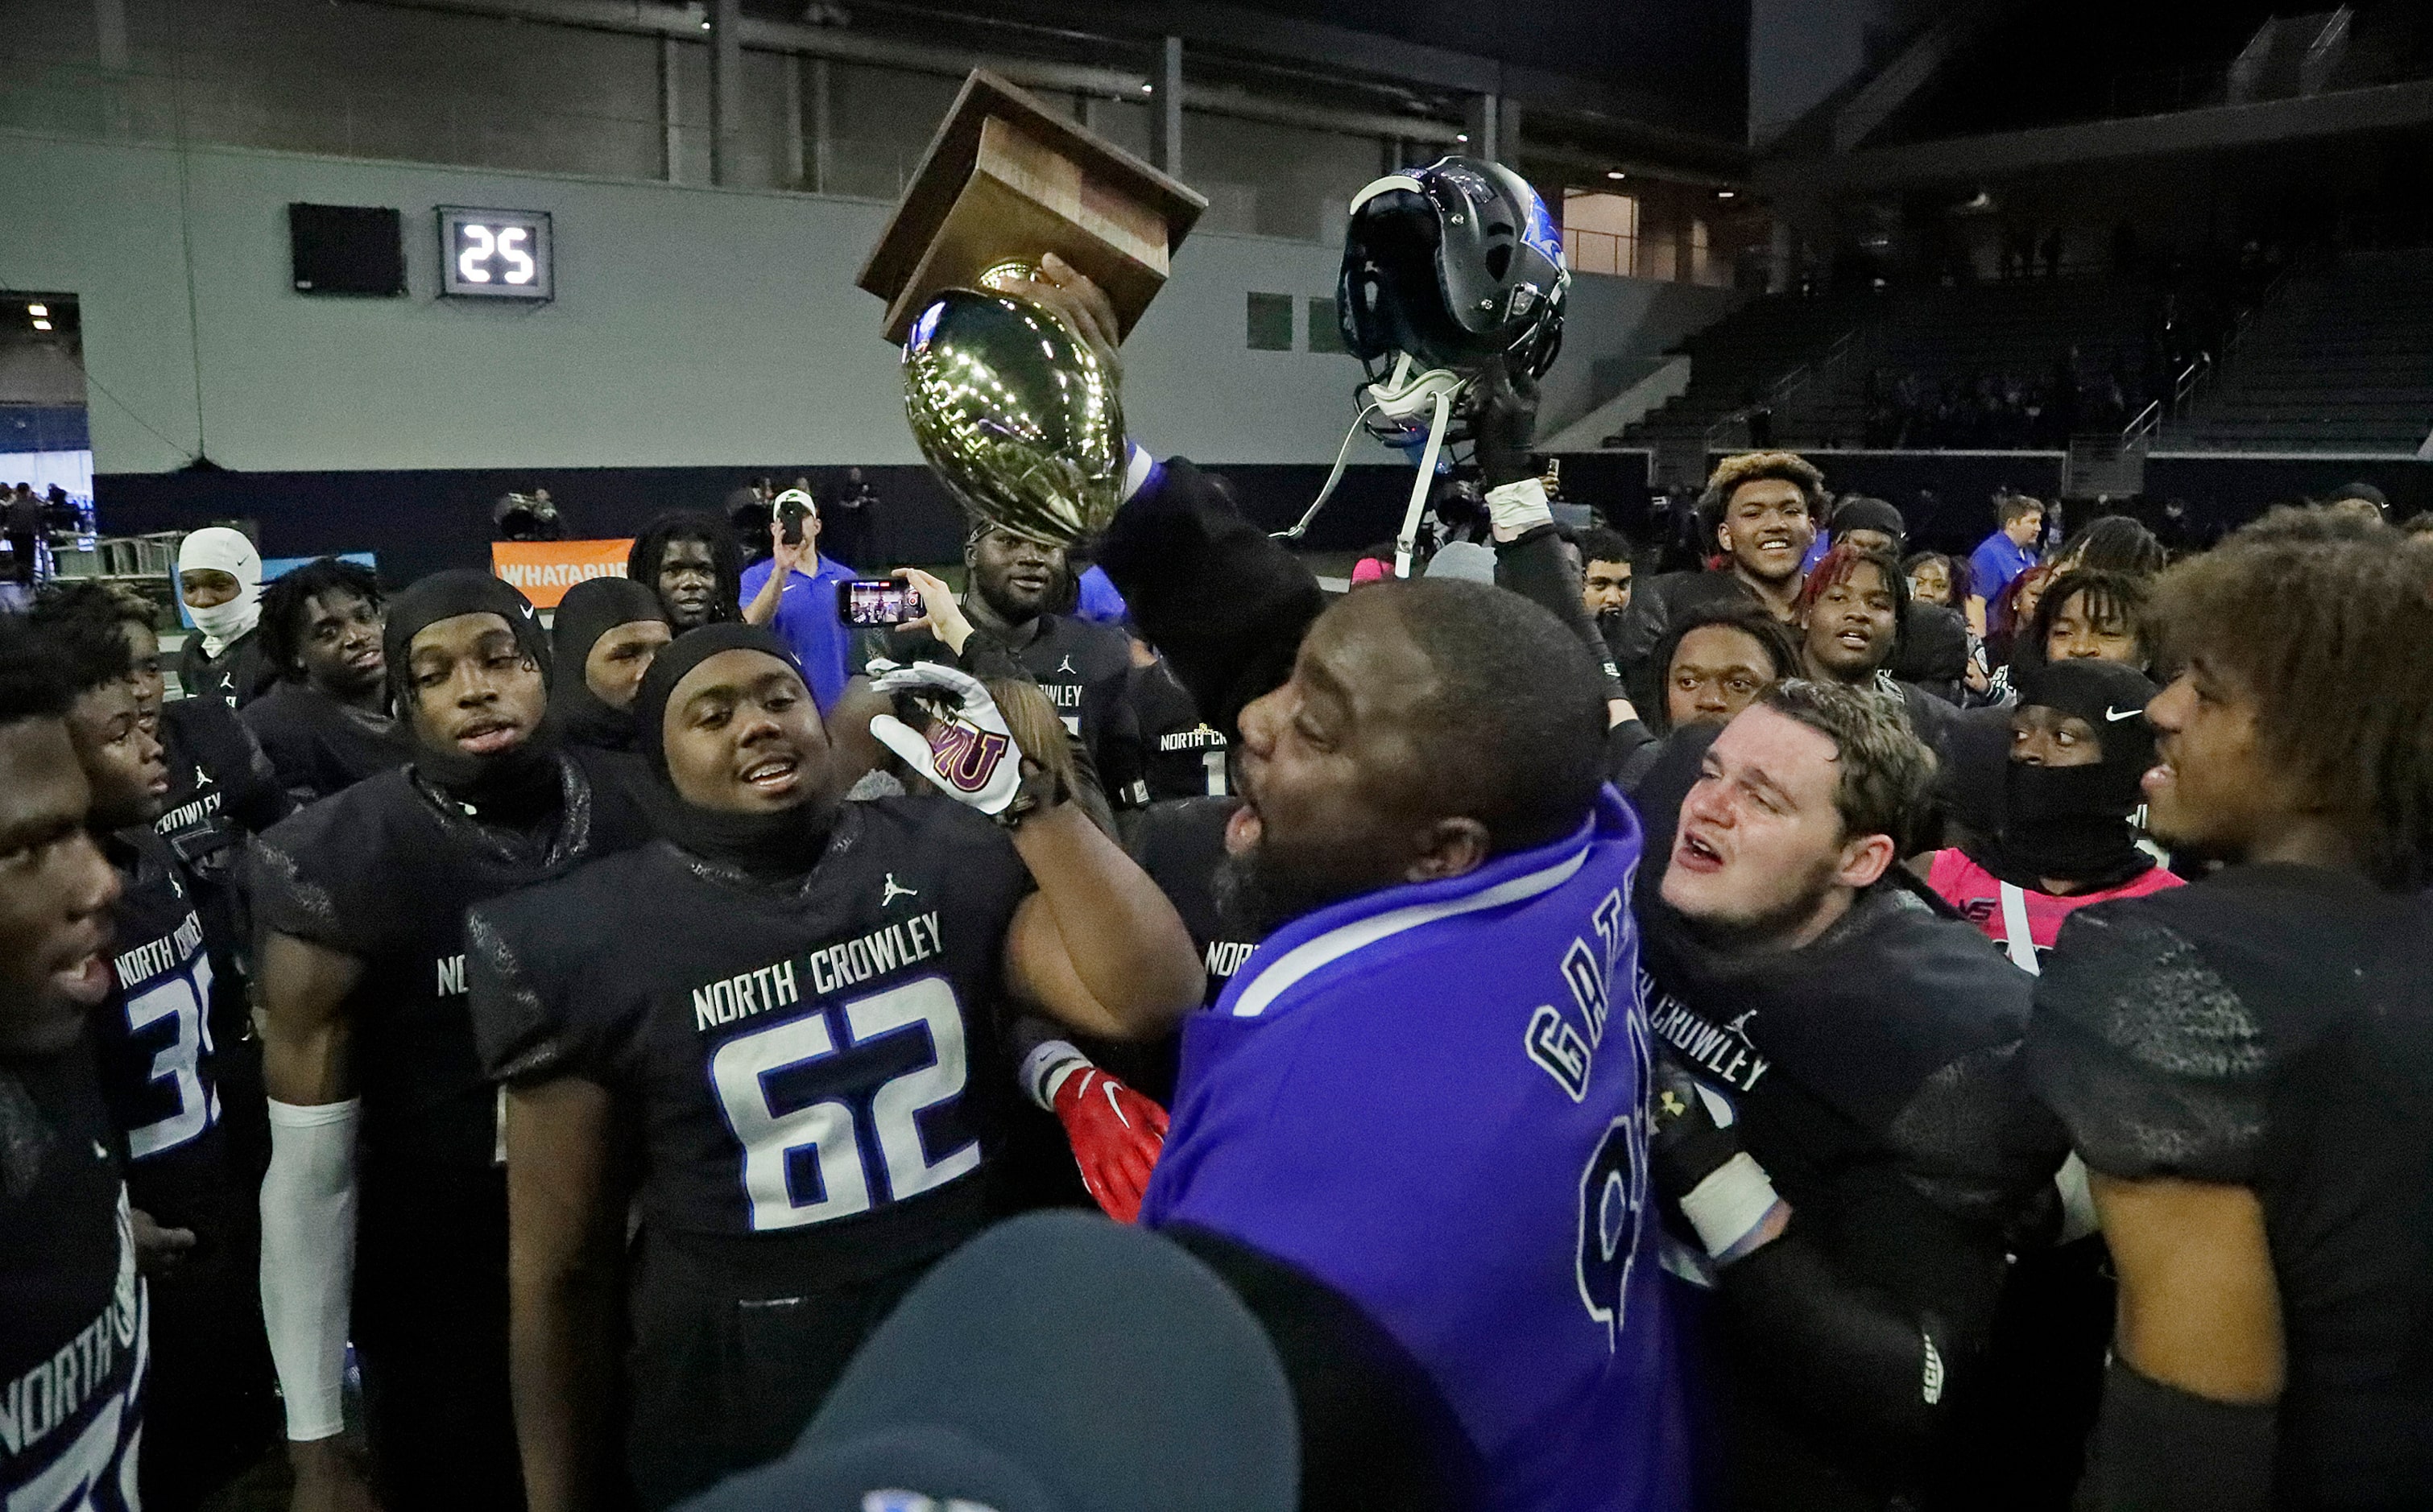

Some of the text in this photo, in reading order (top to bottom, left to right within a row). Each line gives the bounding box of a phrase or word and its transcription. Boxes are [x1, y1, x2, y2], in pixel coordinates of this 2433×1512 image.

[459, 225, 534, 284] 25
[1038, 684, 1083, 707] WLEY
[1161, 731, 1205, 752] NORTH
[114, 936, 176, 990] NORTH
[692, 911, 942, 1032] NORTH CROWLEY
[1204, 940, 1261, 977] NOR
[1649, 993, 1771, 1093] CROWLEY
[710, 974, 982, 1232] 62
